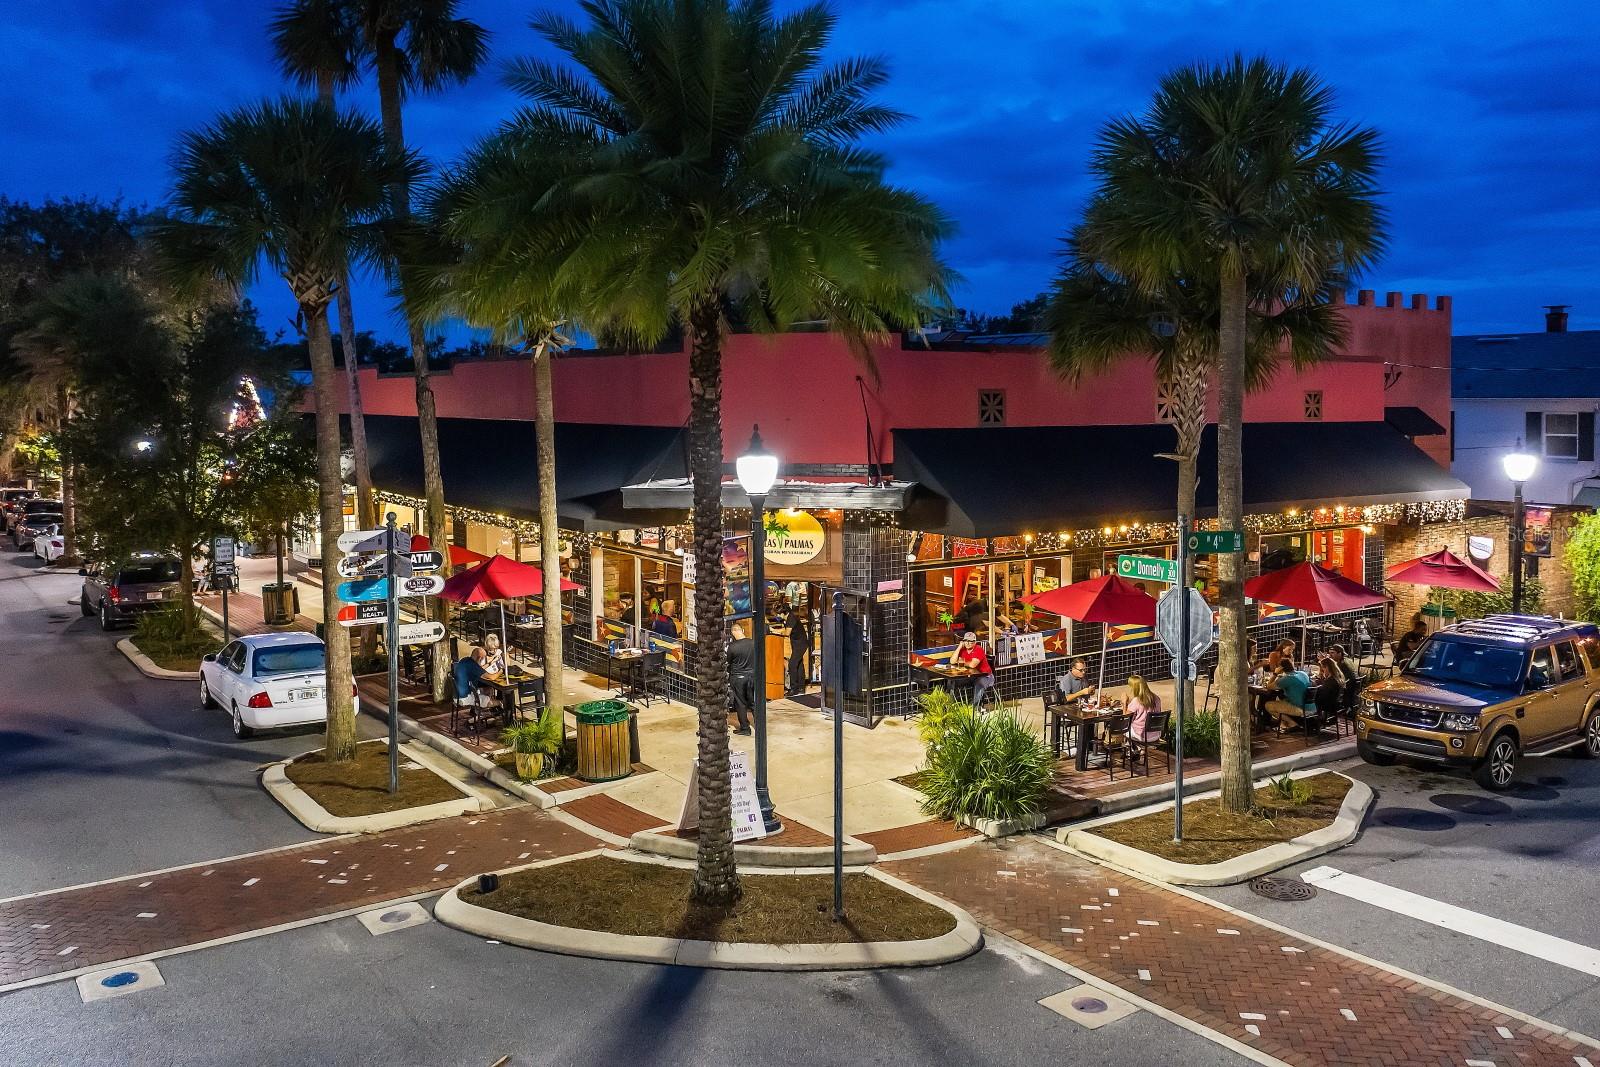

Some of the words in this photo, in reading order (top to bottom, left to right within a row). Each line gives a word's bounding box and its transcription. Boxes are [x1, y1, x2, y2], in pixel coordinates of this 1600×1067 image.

[784, 539, 814, 549] PALMAS
[410, 553, 432, 563] ATM
[1137, 560, 1164, 579] Donnelly
